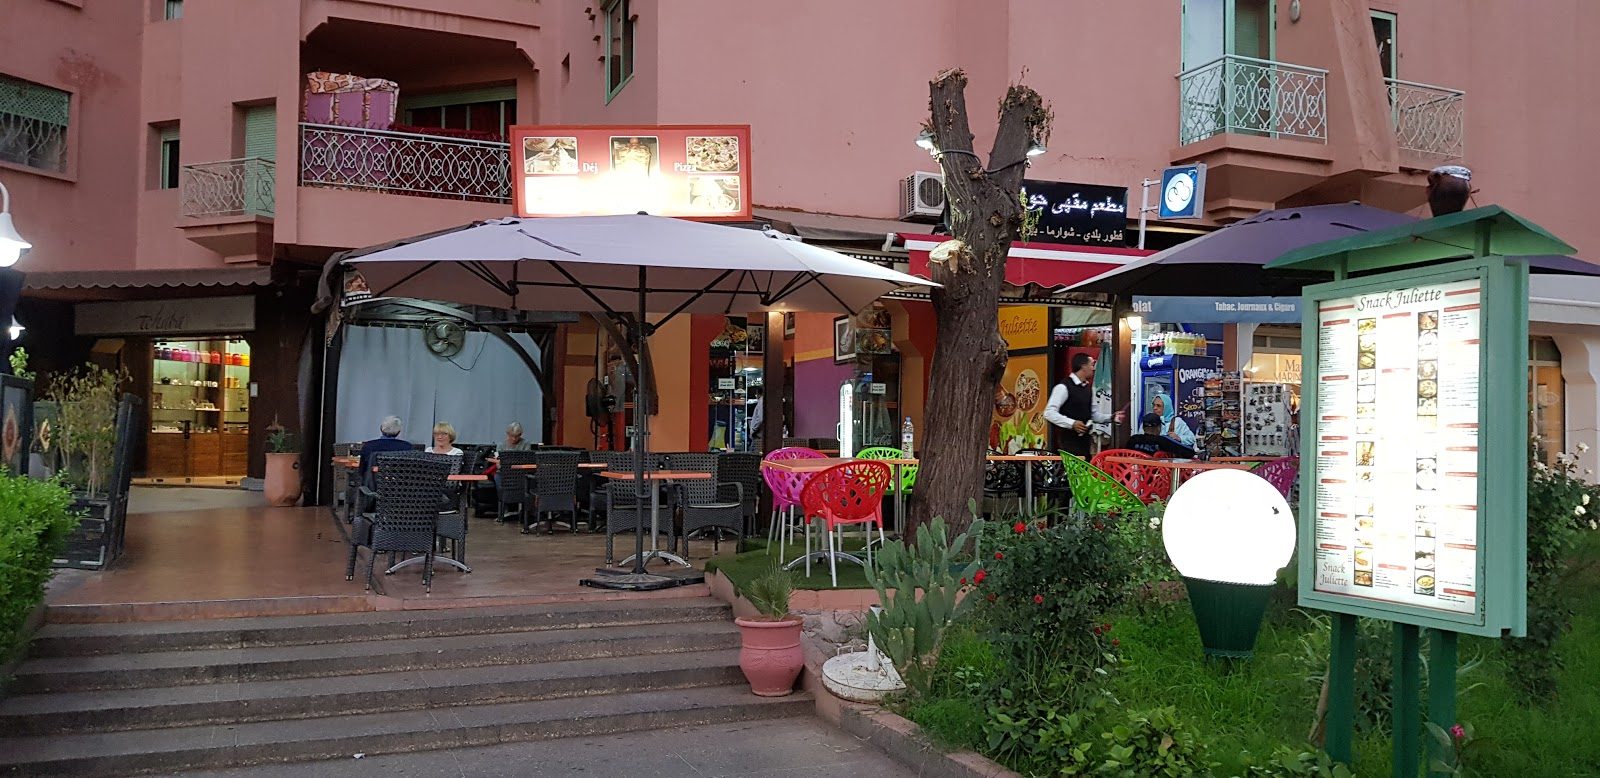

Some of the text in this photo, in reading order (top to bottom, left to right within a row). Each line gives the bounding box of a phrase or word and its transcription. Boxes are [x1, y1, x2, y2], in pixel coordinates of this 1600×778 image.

[674, 162, 697, 172] Pizza
[1090, 196, 1125, 218] مطعم
[1046, 226, 1075, 238] شوارما
[1083, 229, 1101, 242] بلدي
[1102, 229, 1123, 242] فطور
[1357, 287, 1442, 311] Snack Juliette
[1132, 300, 1152, 313] olat
[1285, 359, 1302, 372] Ma
[1179, 368, 1214, 383] ORANGI
[1273, 371, 1302, 383] MARIN
[1323, 561, 1346, 574] Snack
[1320, 573, 1348, 586] Juliette
